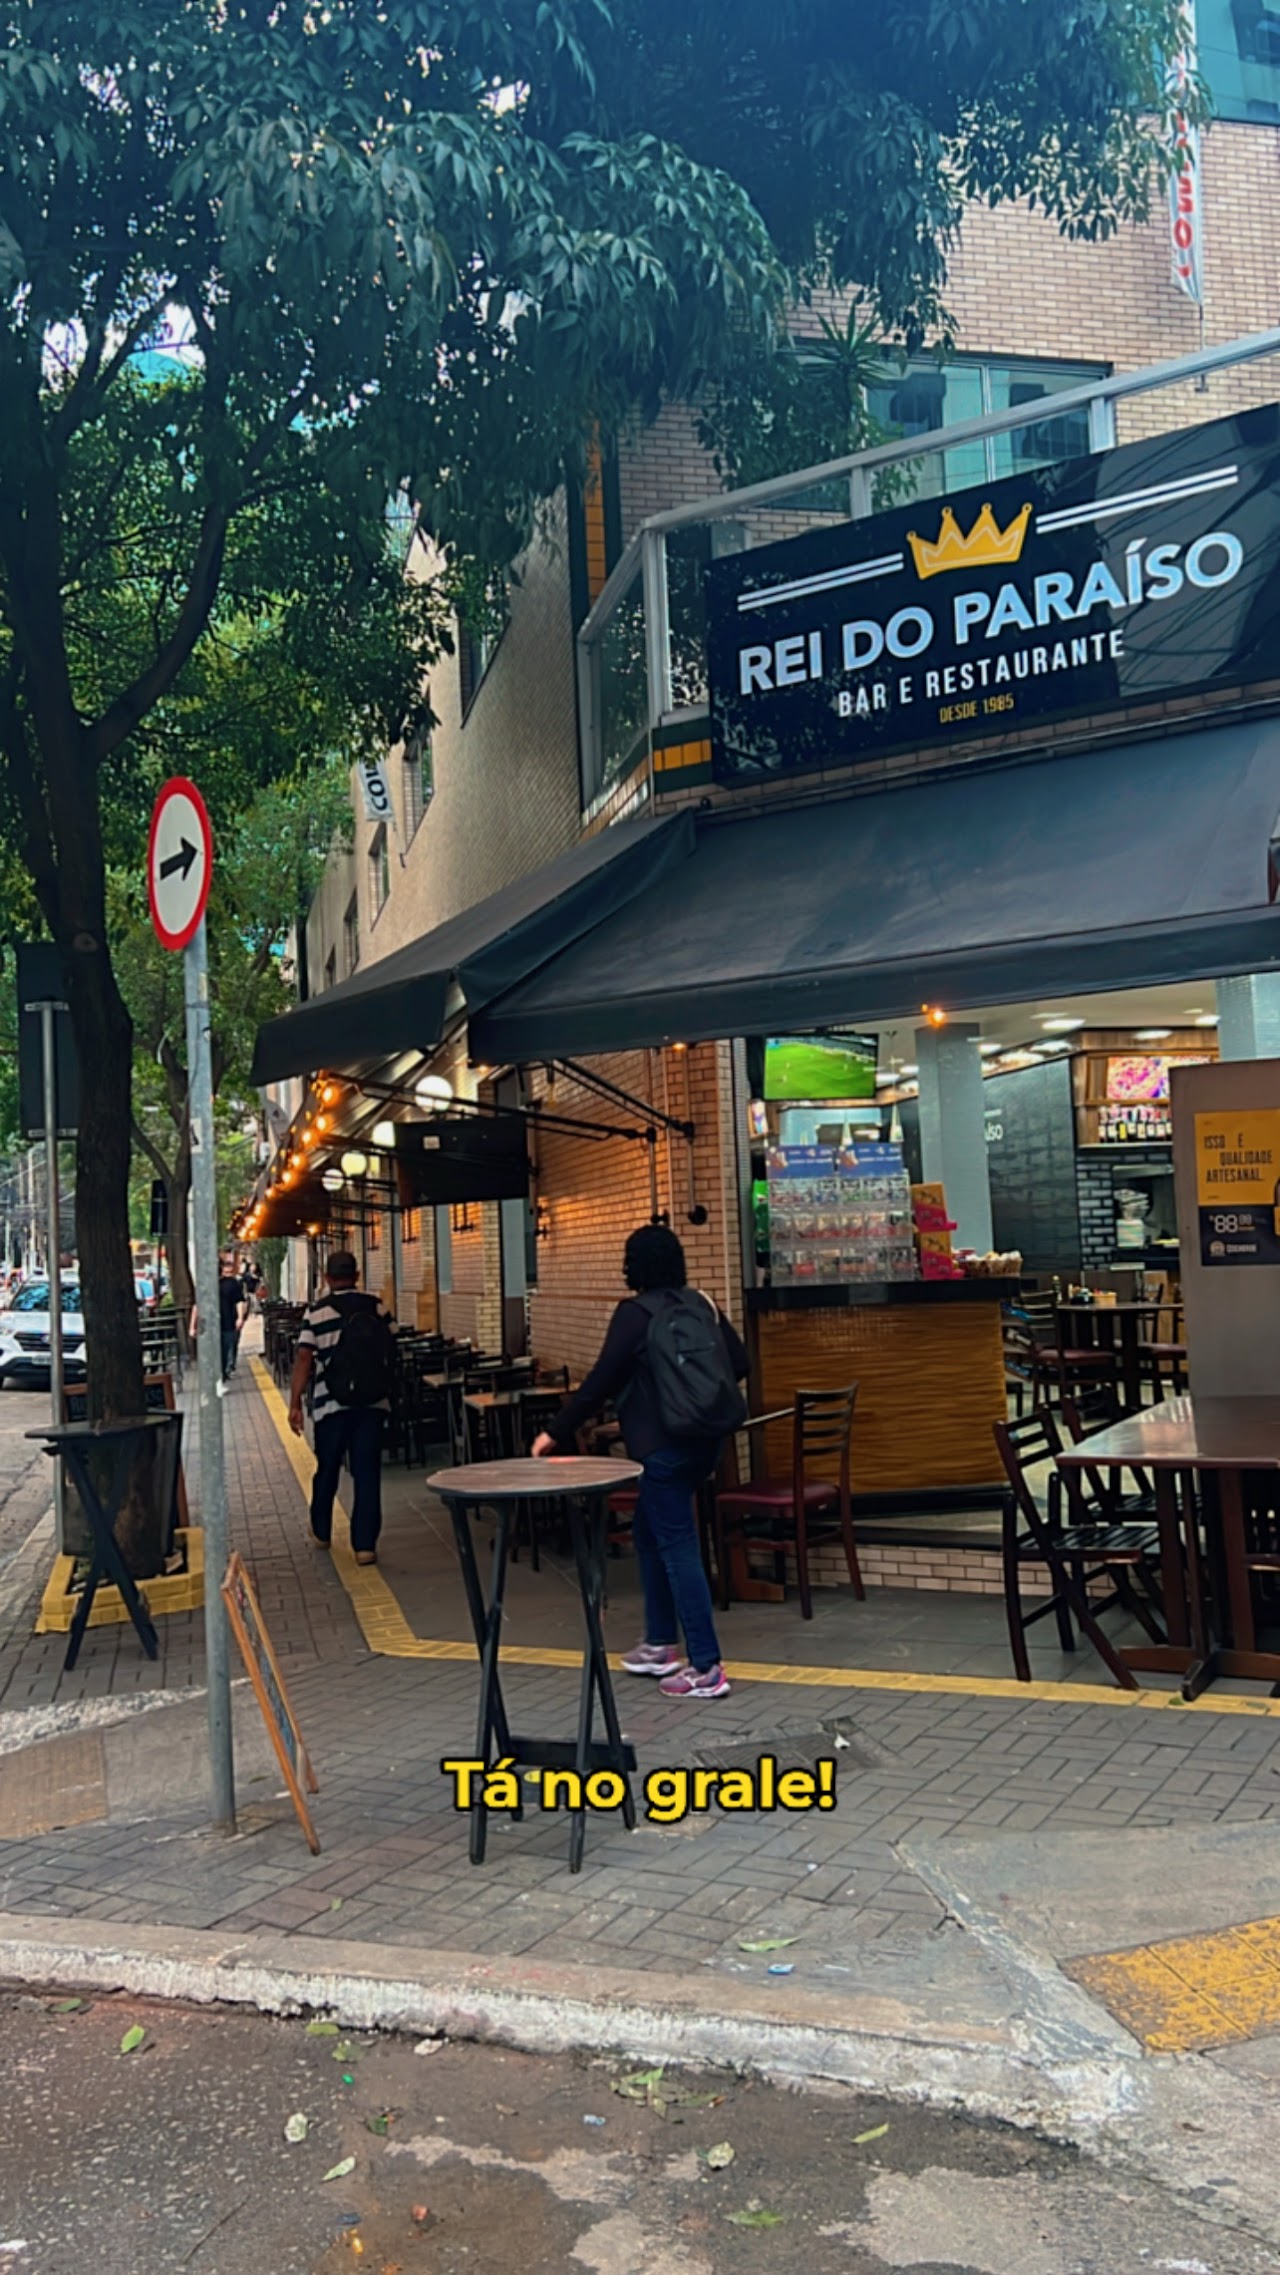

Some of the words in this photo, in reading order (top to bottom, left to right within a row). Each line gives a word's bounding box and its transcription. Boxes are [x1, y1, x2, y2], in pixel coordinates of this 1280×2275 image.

[739, 630, 823, 696] REI
[842, 605, 934, 672] DO
[953, 531, 1244, 646] PARAÍSO
[838, 682, 887, 718] BAR
[899, 676, 913, 705] E
[925, 628, 1125, 698] RESTAURANTE
[939, 699, 978, 725] DESDE
[982, 693, 1014, 714] 1985
[1204, 1134, 1226, 1150] ISSO
[1219, 1150, 1273, 1166] QUALIDADE
